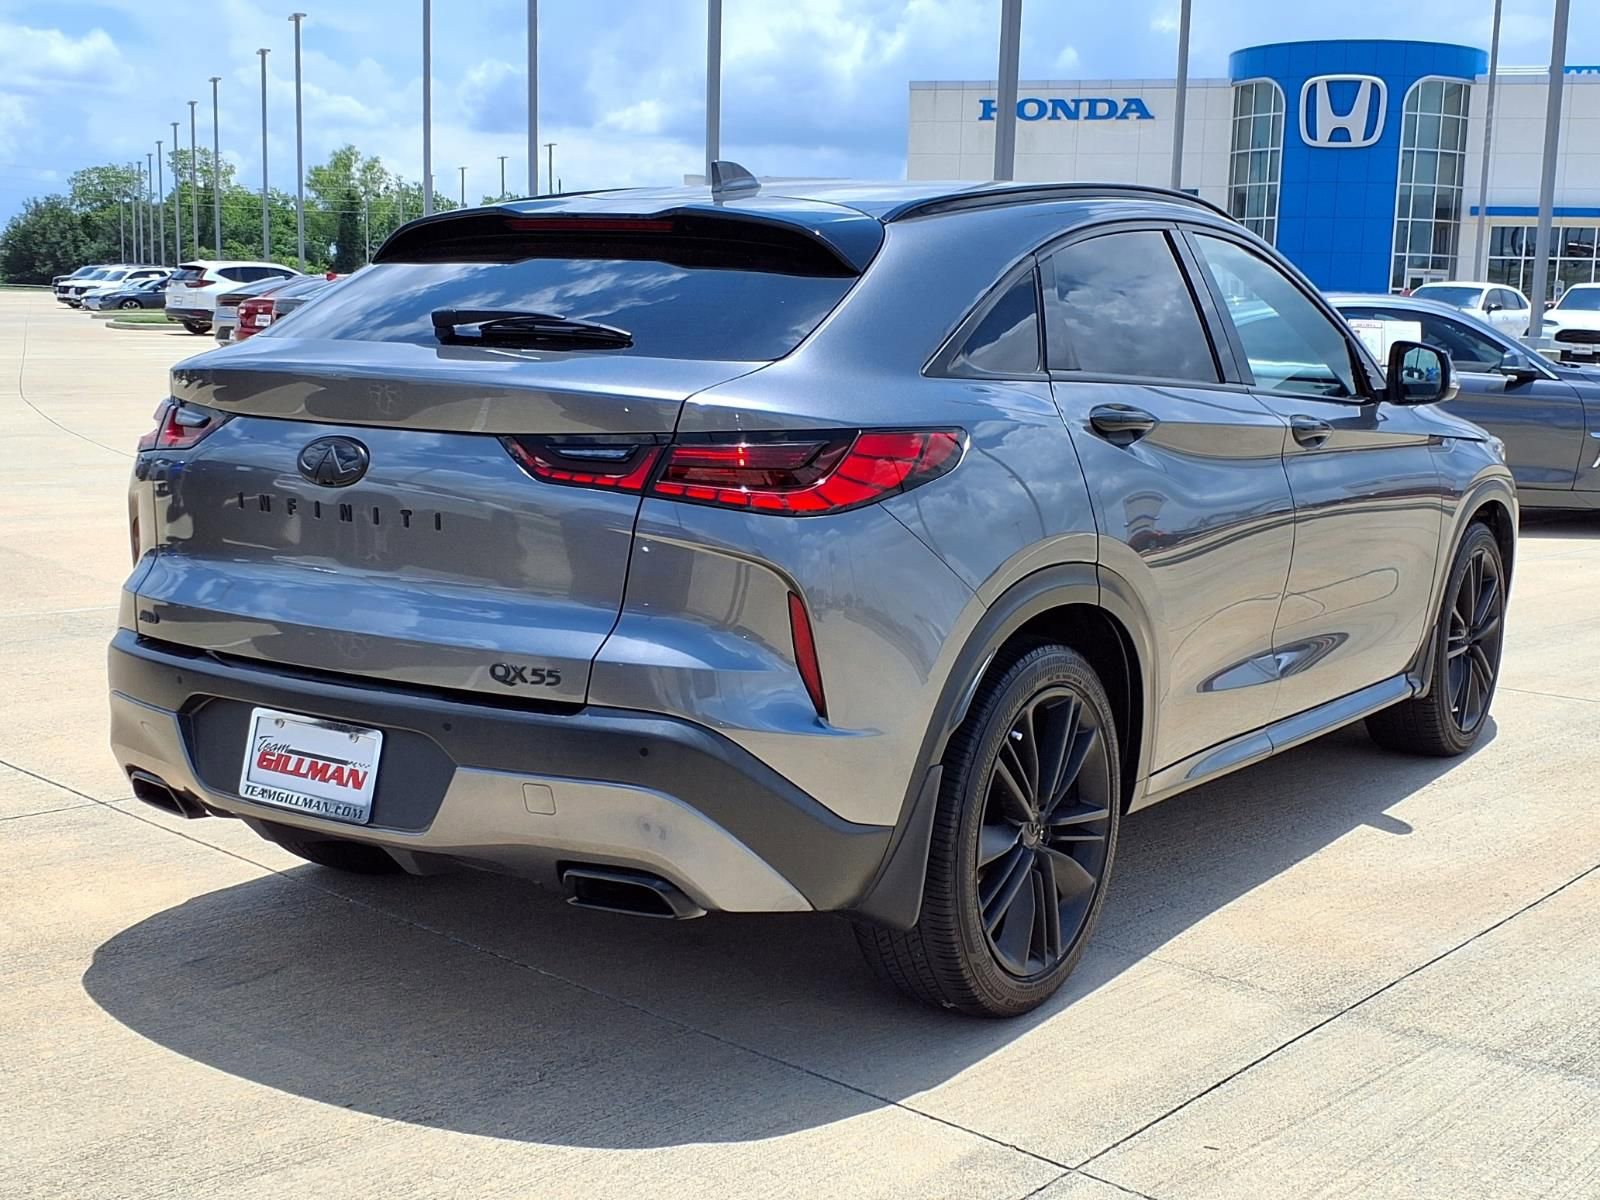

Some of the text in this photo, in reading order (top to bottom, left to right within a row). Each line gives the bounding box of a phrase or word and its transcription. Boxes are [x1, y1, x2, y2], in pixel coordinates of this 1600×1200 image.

[238, 492, 443, 531] INFINITI
[489, 663, 562, 687] QX55
[257, 735, 291, 753] Team
[256, 751, 369, 791] GILLMAN
[244, 784, 364, 820] TEAMGILLMAN.COM
